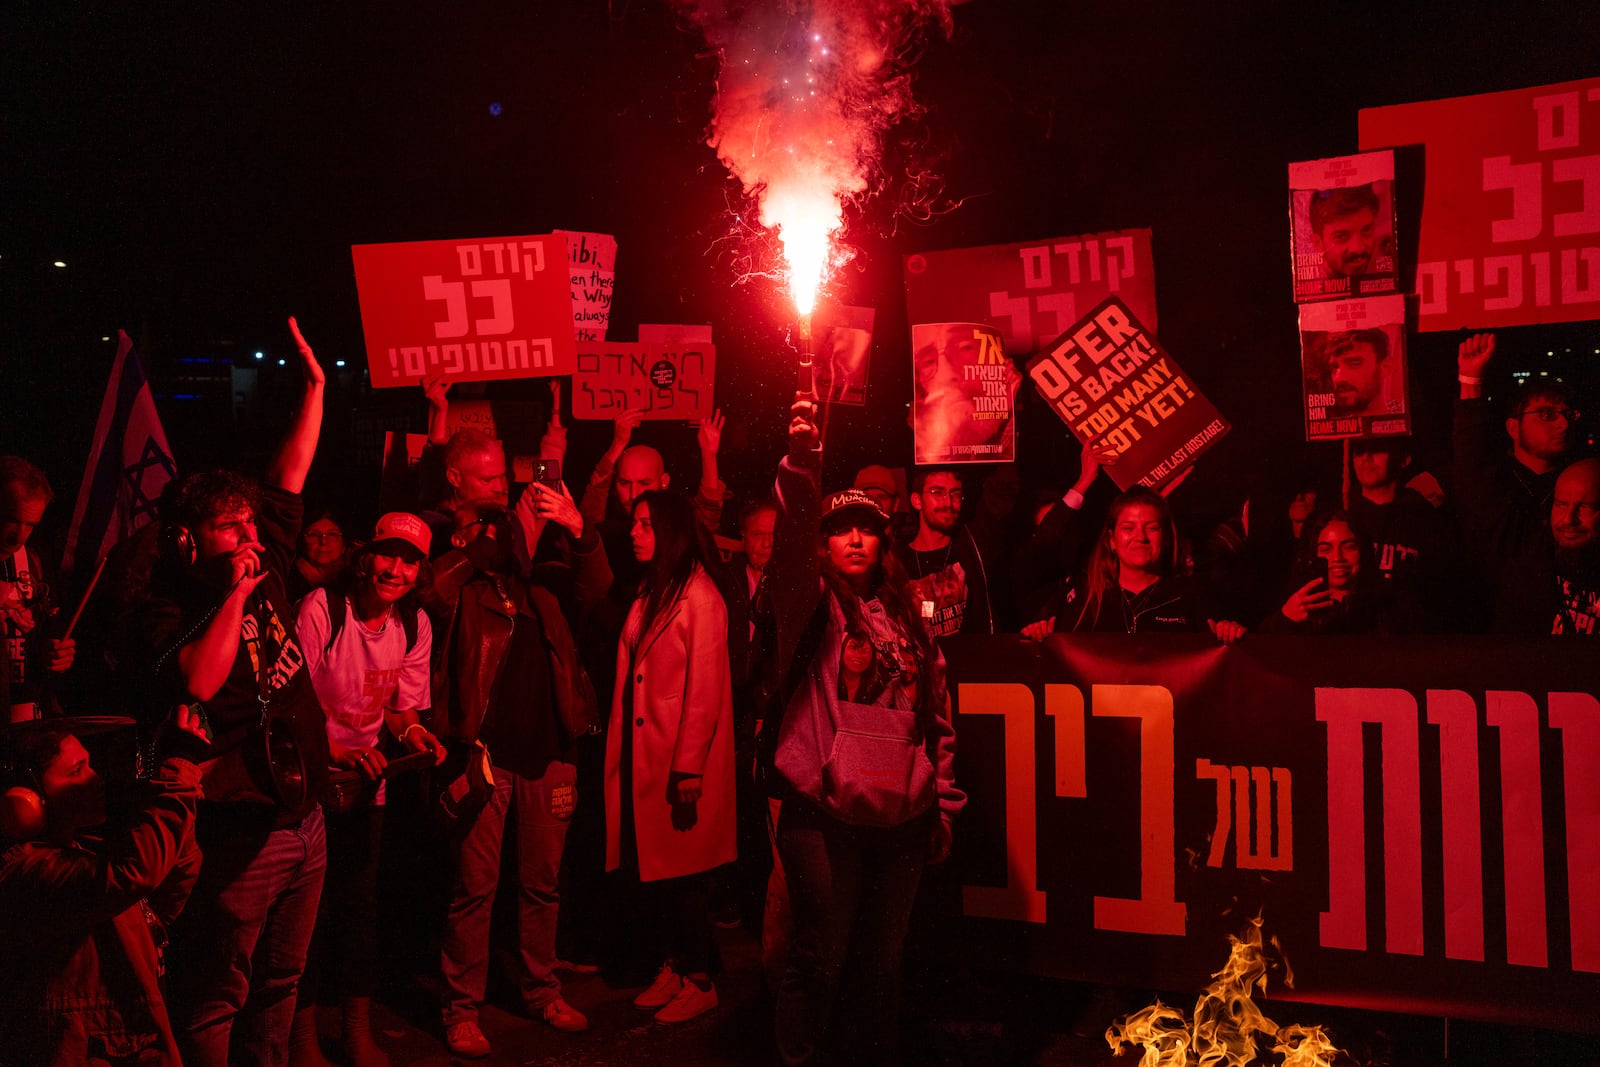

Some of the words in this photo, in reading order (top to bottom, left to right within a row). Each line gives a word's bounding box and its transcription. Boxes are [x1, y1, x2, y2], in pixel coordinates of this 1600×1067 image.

[456, 241, 545, 281] קודם
[566, 236, 602, 268] ibi,
[1019, 236, 1135, 292] קודם
[1297, 252, 1324, 267] BRING
[570, 275, 586, 287] en
[1297, 266, 1315, 281] HIM
[1297, 280, 1323, 296] HOME
[1325, 276, 1351, 294] NOW!
[423, 275, 514, 338] כל
[584, 288, 611, 308] Why
[574, 307, 610, 325] always
[577, 328, 597, 341] the
[973, 329, 1005, 365] אל
[388, 338, 555, 377] החטופים!
[577, 353, 648, 377] אדם
[1030, 304, 1140, 400] OFER
[963, 365, 1007, 381] תשאירו
[1056, 390, 1088, 423] IS
[1081, 333, 1157, 402] BACK!
[582, 382, 628, 411] הכל
[634, 379, 700, 412] לפני
[981, 381, 1008, 397] אותי
[1076, 402, 1121, 438] TOO
[1113, 357, 1174, 413] MANY
[1135, 376, 1195, 427] YET!
[1308, 392, 1336, 408] BRING
[973, 396, 1009, 412] מאחור
[1308, 407, 1326, 421] HIM
[1309, 420, 1335, 435] HOME
[1336, 416, 1363, 433] NOW!
[1150, 462, 1170, 481] THE
[1164, 447, 1189, 470] LAST
[1184, 418, 1225, 455] HOSTAGE!
[945, 683, 1187, 937] ביב
[1196, 758, 1293, 872] של
